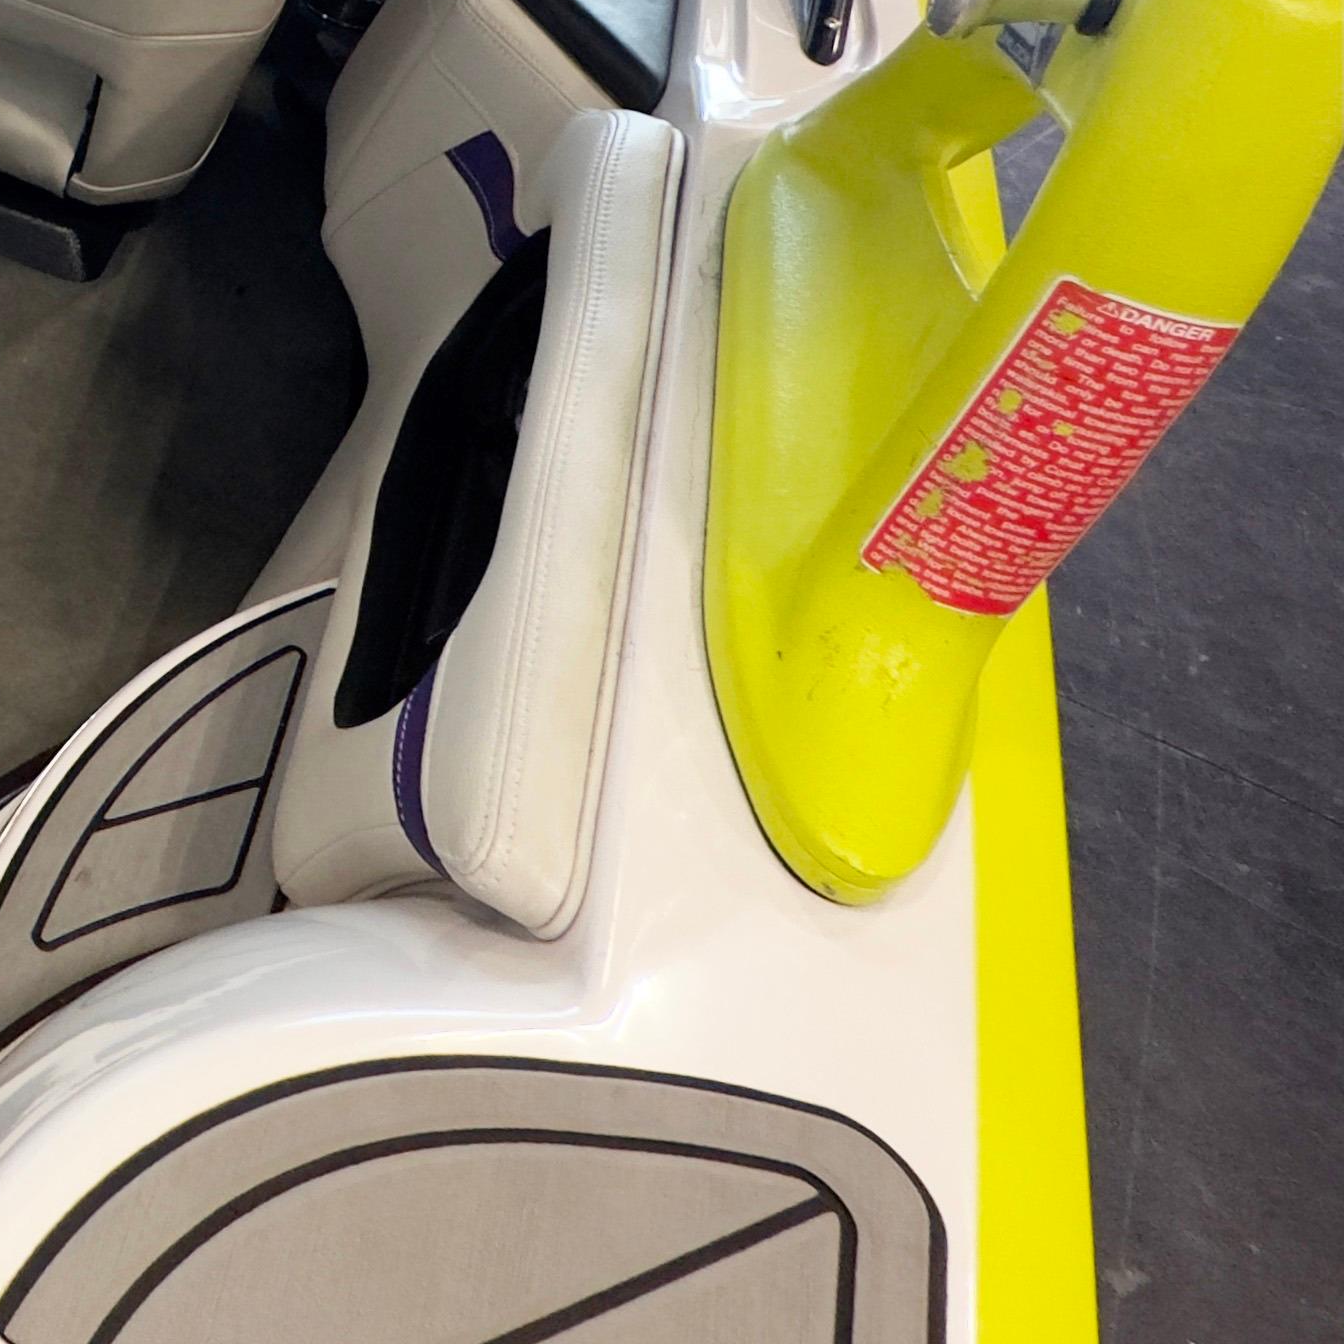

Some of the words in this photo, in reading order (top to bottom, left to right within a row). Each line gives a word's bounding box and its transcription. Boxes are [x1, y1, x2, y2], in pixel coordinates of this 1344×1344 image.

[1057, 296, 1105, 325] Failure
[1119, 324, 1135, 336] to
[1118, 307, 1218, 342] DANGER
[1033, 328, 1070, 351] more
[1062, 355, 1095, 375] time
[1078, 372, 1105, 392] The
[1064, 384, 1096, 403] only
